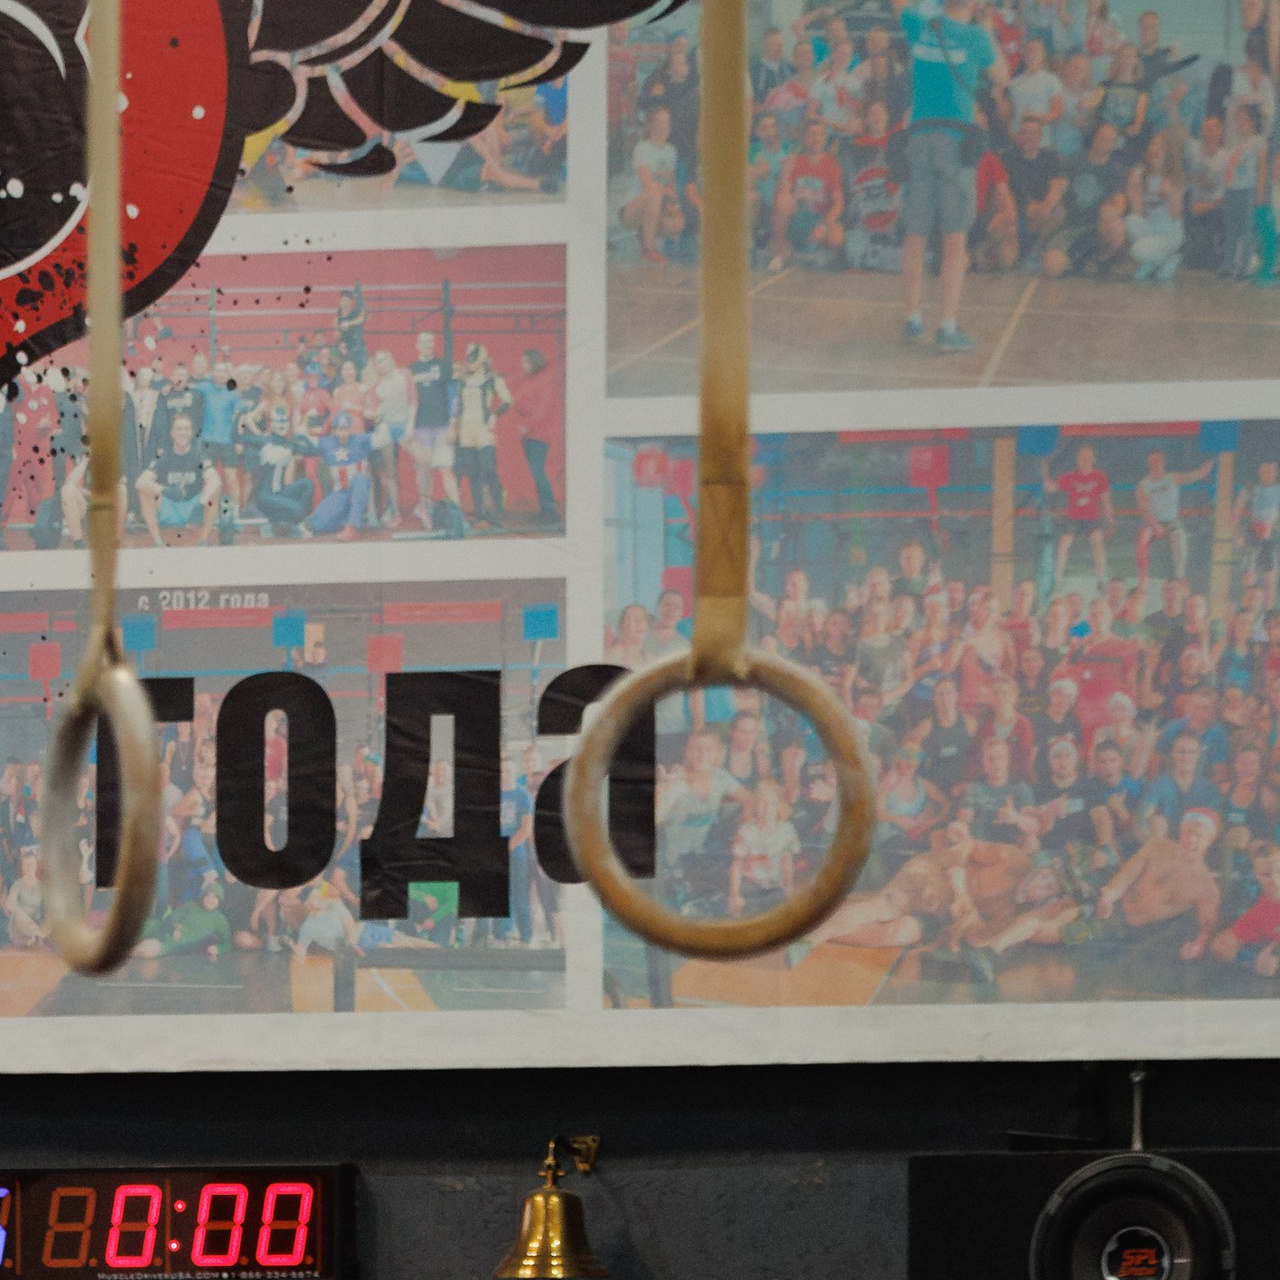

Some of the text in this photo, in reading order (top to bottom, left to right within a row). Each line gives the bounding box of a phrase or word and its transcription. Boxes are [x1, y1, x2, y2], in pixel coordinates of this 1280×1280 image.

[158, 590, 210, 610] 2012
[94, 663, 657, 919] года
[104, 1181, 314, 1268] 0:00
